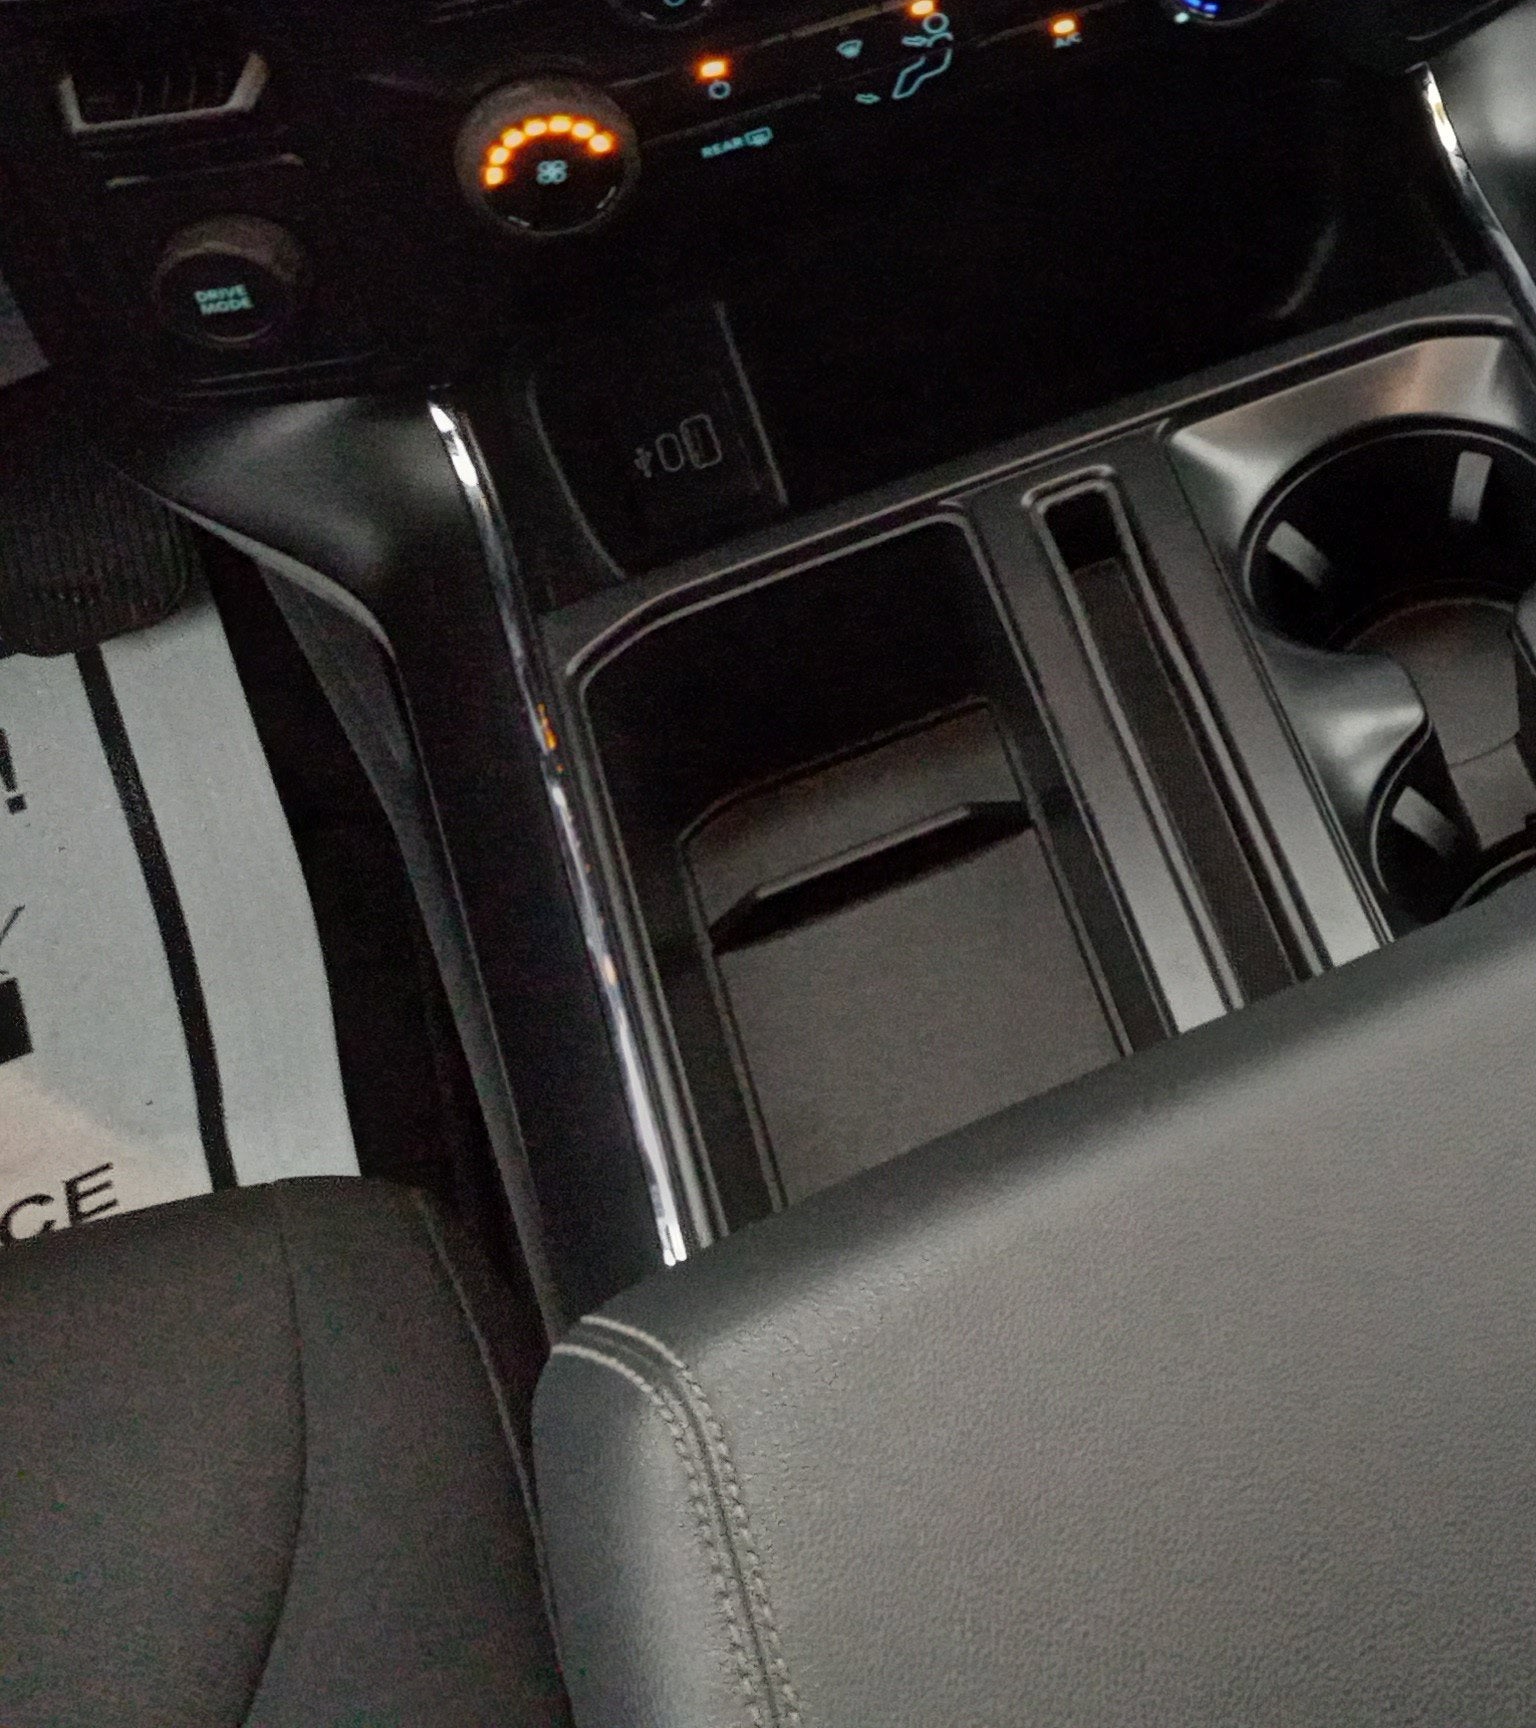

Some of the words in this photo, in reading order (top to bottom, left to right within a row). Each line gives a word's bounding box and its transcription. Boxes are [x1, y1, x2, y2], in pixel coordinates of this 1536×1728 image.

[701, 136, 744, 159] REAR
[194, 284, 247, 303] DRIVE
[201, 297, 255, 315] MODE
